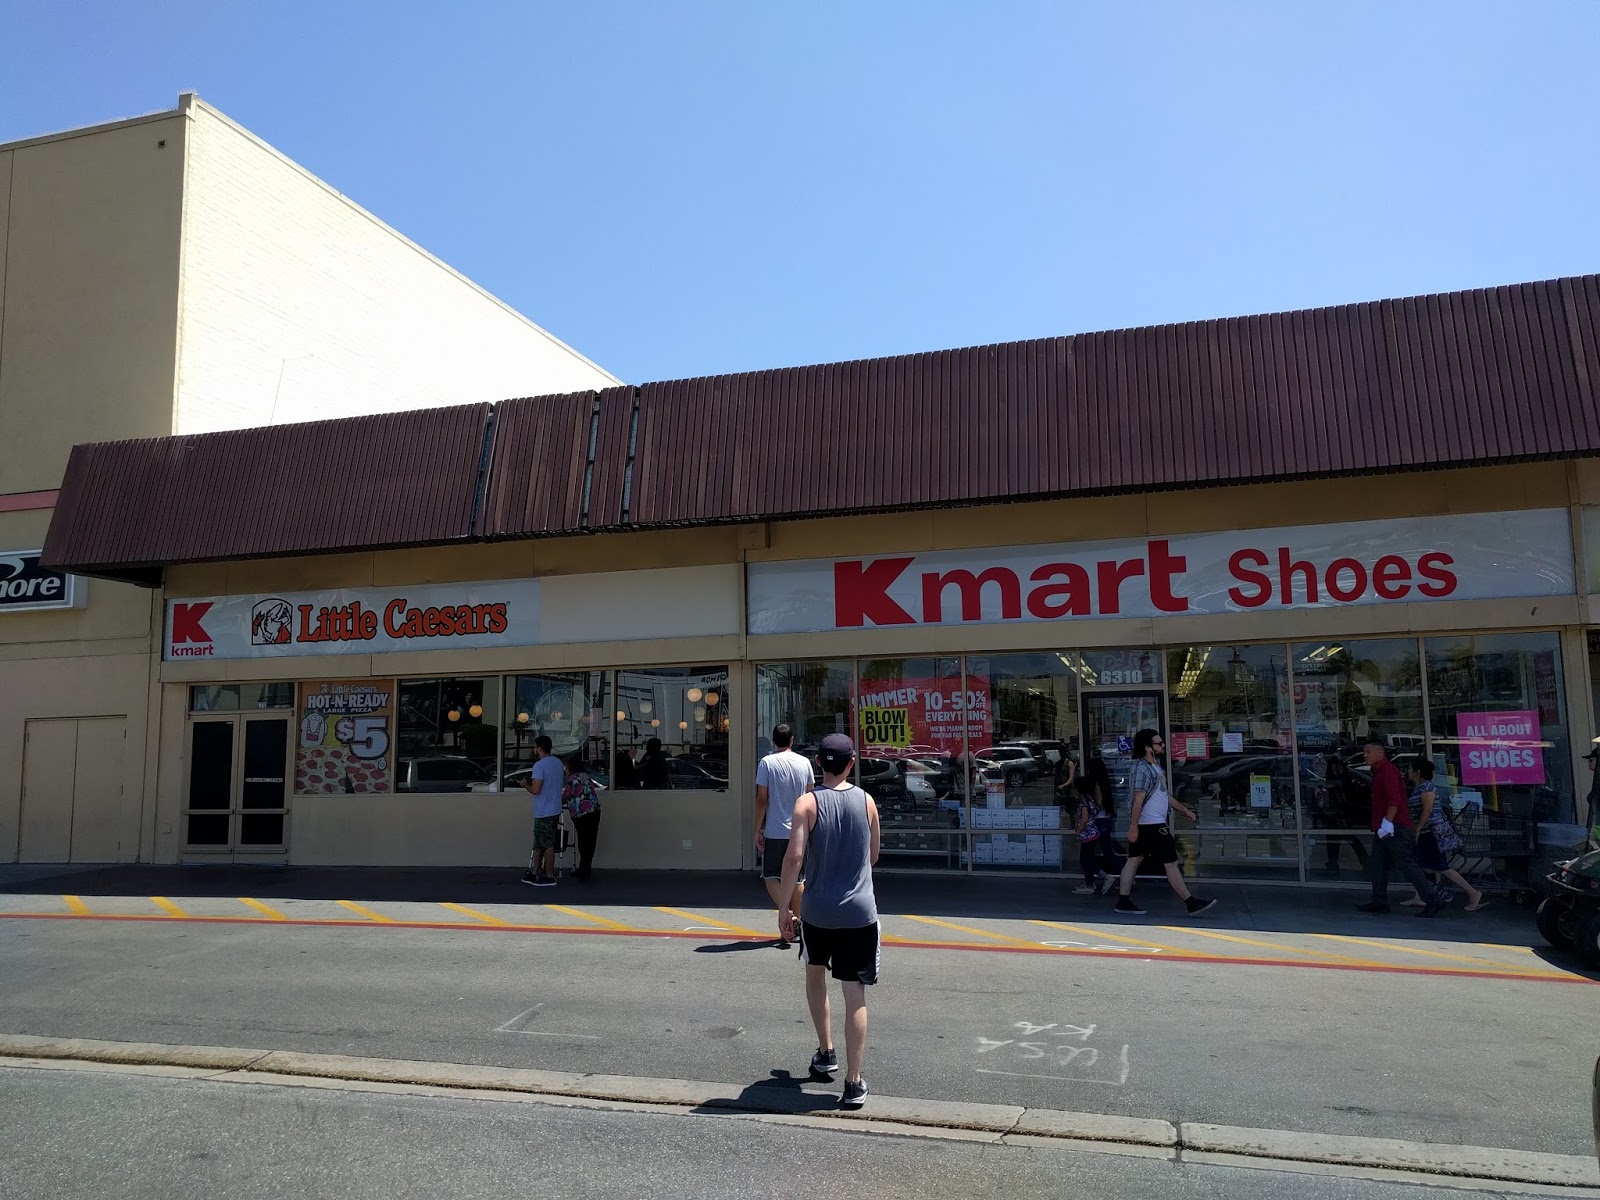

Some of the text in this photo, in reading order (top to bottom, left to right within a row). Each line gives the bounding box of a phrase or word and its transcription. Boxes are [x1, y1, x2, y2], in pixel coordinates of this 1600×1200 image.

[834, 539, 1458, 628] Kmart Shoes
[172, 602, 214, 643] K
[296, 598, 508, 643] Little Caesars
[171, 644, 214, 656] kmart
[1101, 669, 1143, 684] 6310
[331, 685, 378, 693] Little Caesars
[865, 710, 906, 725] BLOW
[335, 716, 390, 760] $5
[865, 725, 905, 743] OUT!
[1466, 723, 1532, 737] ALL ABOUT
[1468, 749, 1535, 769] SHOES
